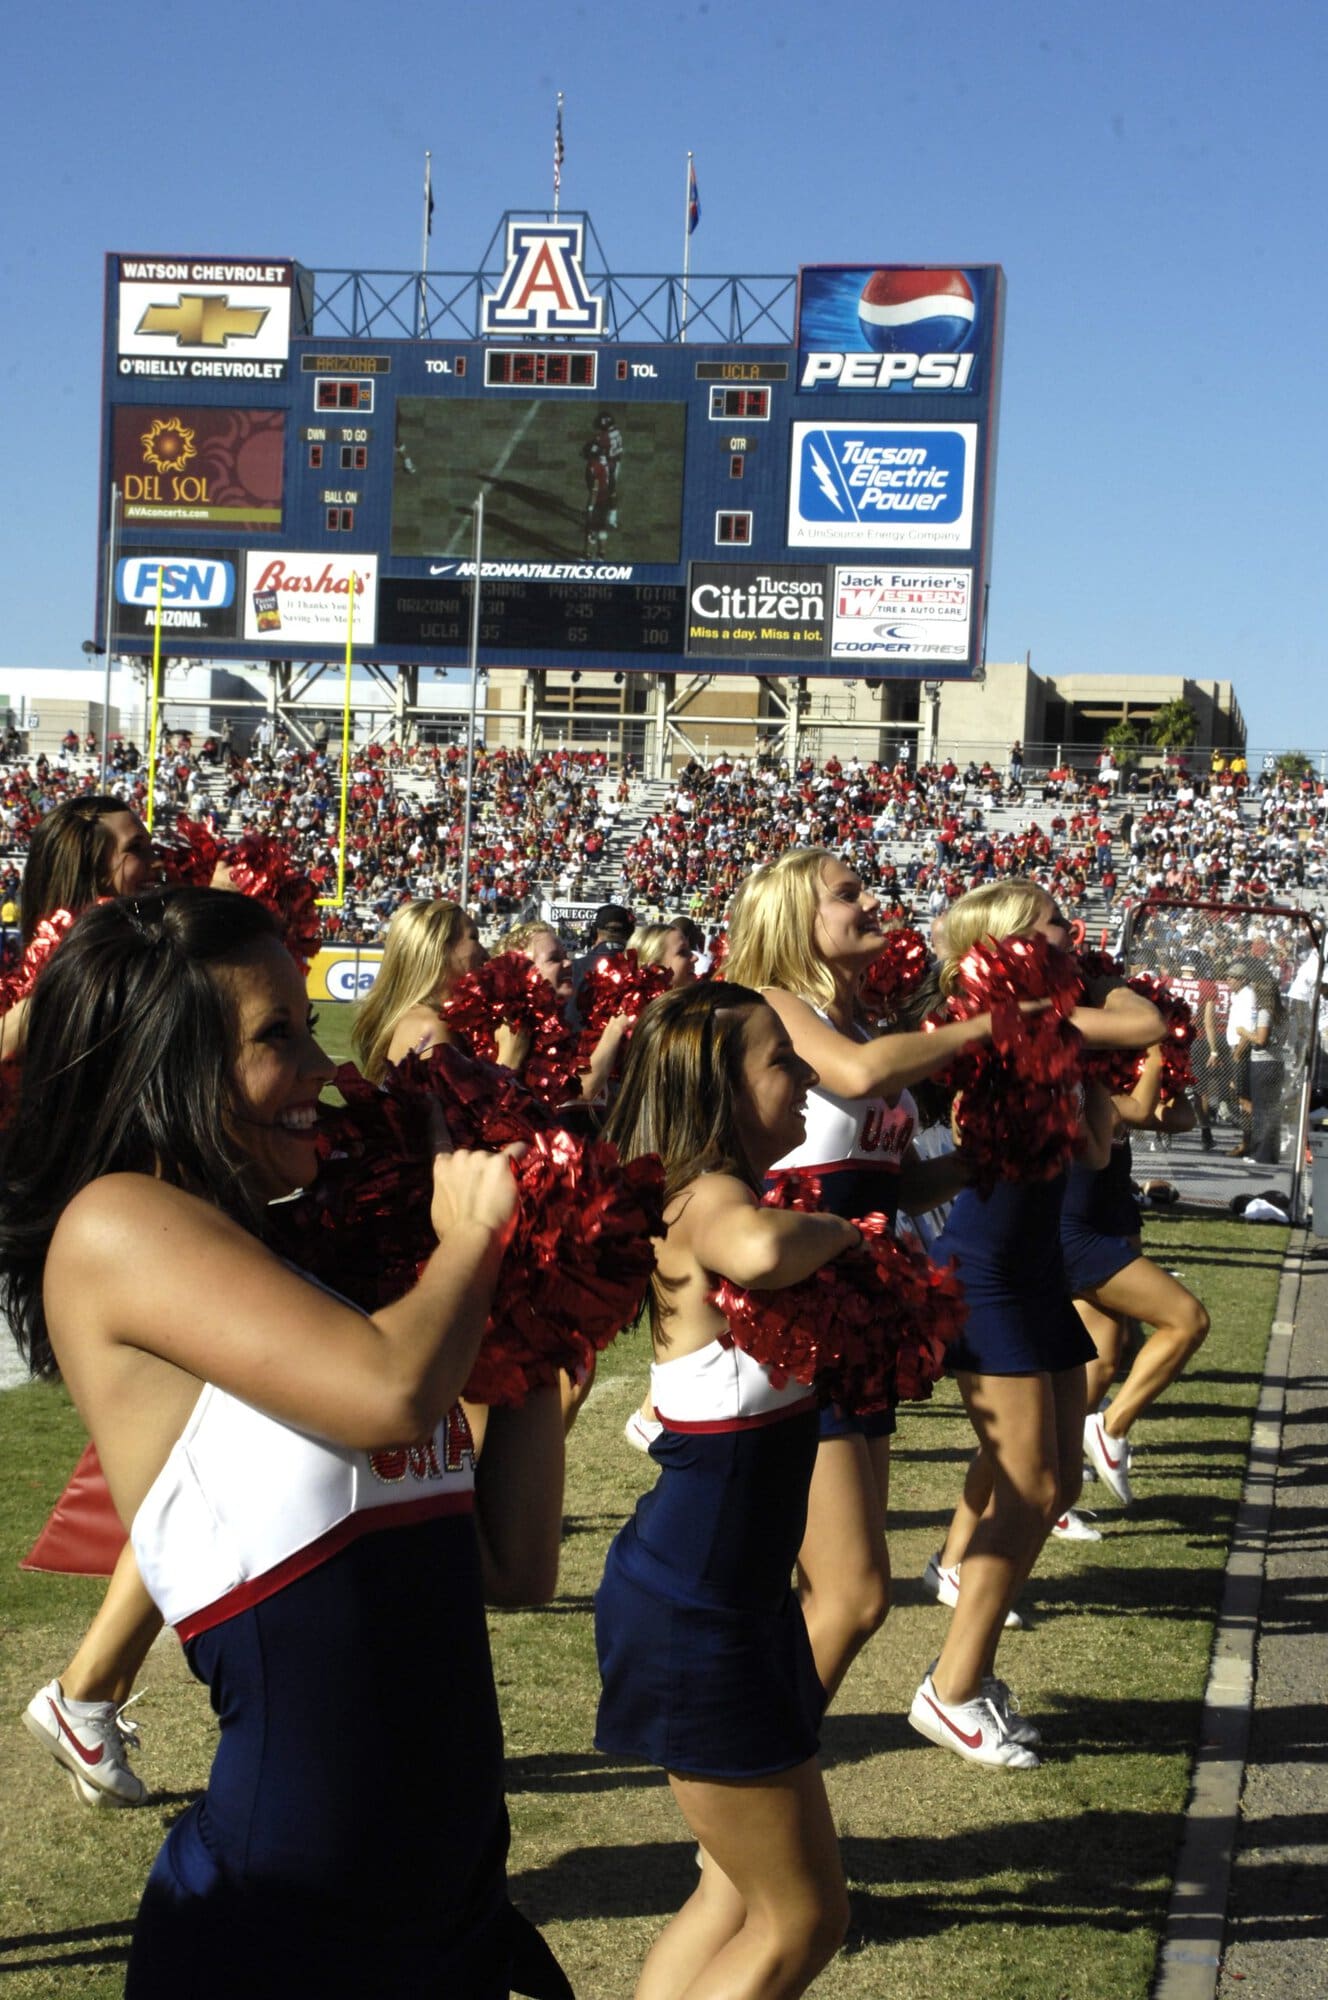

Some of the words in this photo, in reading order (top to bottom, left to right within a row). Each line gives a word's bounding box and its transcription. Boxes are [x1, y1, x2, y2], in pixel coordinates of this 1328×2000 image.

[123, 263, 190, 280] WATSON
[192, 266, 286, 282] CHEVROLET
[119, 359, 187, 376] O'RIELLY
[191, 361, 284, 378] CHEVROLET
[316, 356, 377, 372] ARIZONA
[425, 360, 452, 373] TOL
[631, 364, 658, 378] TOL
[721, 364, 760, 380] UCLA
[800, 352, 974, 389] PEPSI
[736, 390, 768, 416] 14
[307, 428, 326, 441] DWN
[342, 429, 352, 441] TO
[355, 429, 367, 442] GO
[729, 438, 747, 450] QTR
[842, 440, 928, 465] Tucson
[849, 465, 949, 488] Electric
[125, 475, 162, 501] DEL
[172, 476, 210, 502] SOL
[324, 491, 343, 503] BALL
[345, 492, 357, 504] ON
[857, 487, 947, 511] Power
[127, 506, 209, 519] AVAconcerts.com
[868, 529, 904, 541] Energy
[908, 530, 961, 542] Company
[456, 562, 633, 580] ARZONAATHLETICS.COM
[134, 563, 216, 600] FSN
[756, 576, 823, 595] Tucson
[841, 575, 884, 587] Jack
[891, 576, 965, 589] Furrier's
[461, 582, 526, 598] RSHING
[549, 584, 612, 600] PASSING
[635, 586, 678, 601] TOTAL
[397, 598, 459, 614] ARIZONA
[691, 584, 824, 620] Citizen
[877, 605, 897, 613] TIRE
[938, 607, 962, 615] CARE
[145, 609, 201, 628] AIZONA
[420, 623, 459, 639] UCLA
[642, 629, 669, 644] 100
[690, 626, 719, 639] Miss
[722, 629, 729, 639] a
[732, 628, 757, 641] day.
[761, 629, 790, 640] Miss
[793, 631, 800, 640] a
[803, 630, 823, 641] lot.
[1109, 915, 1122, 924] 30
